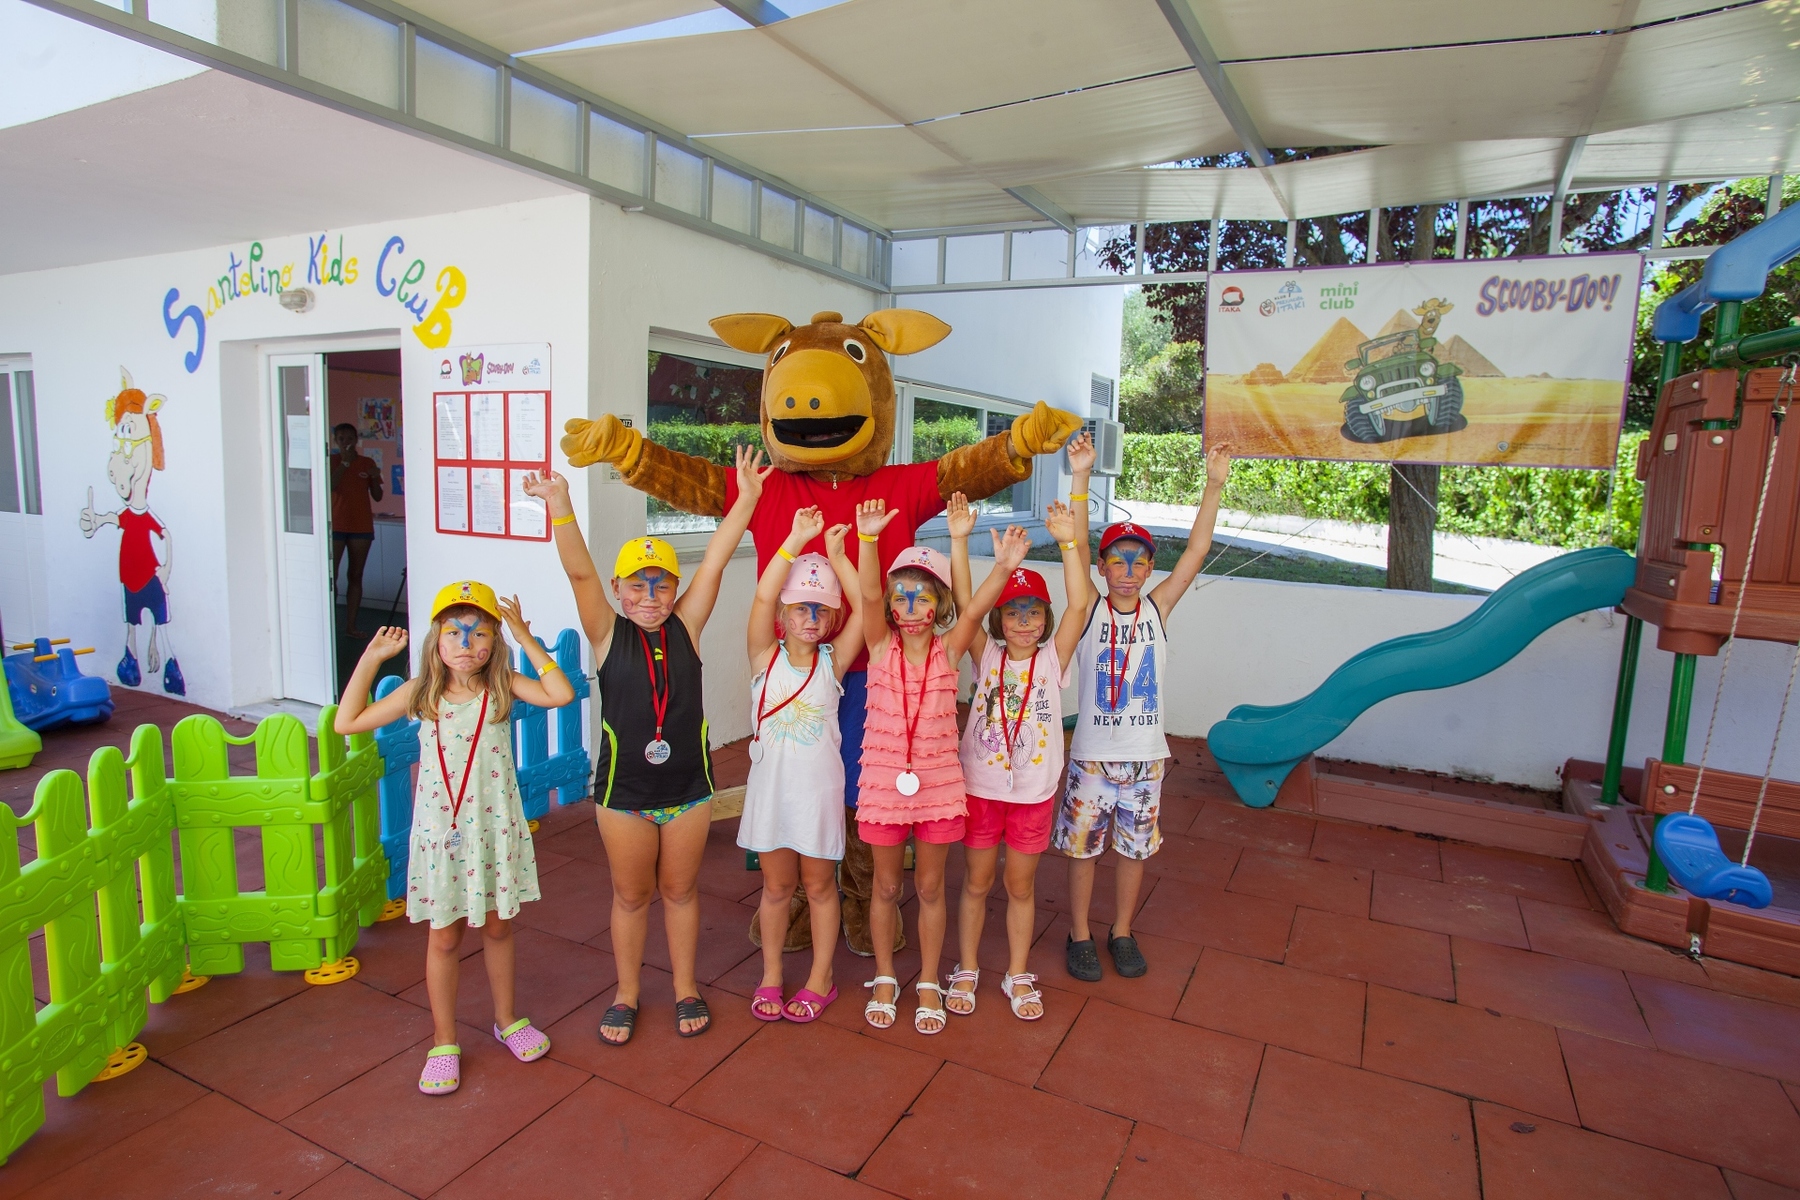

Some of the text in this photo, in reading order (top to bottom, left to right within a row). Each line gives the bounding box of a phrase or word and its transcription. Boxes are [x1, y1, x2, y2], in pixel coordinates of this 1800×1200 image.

[1320, 281, 1359, 297] mini
[1476, 273, 1622, 317] SCOOBY-DOO!
[163, 242, 295, 374] Santelino
[307, 234, 359, 286] Kids
[1276, 301, 1305, 313] ITAKI
[1319, 297, 1355, 310] club
[1095, 644, 1158, 714] 64
[1093, 714, 1159, 726] NEW YORK
